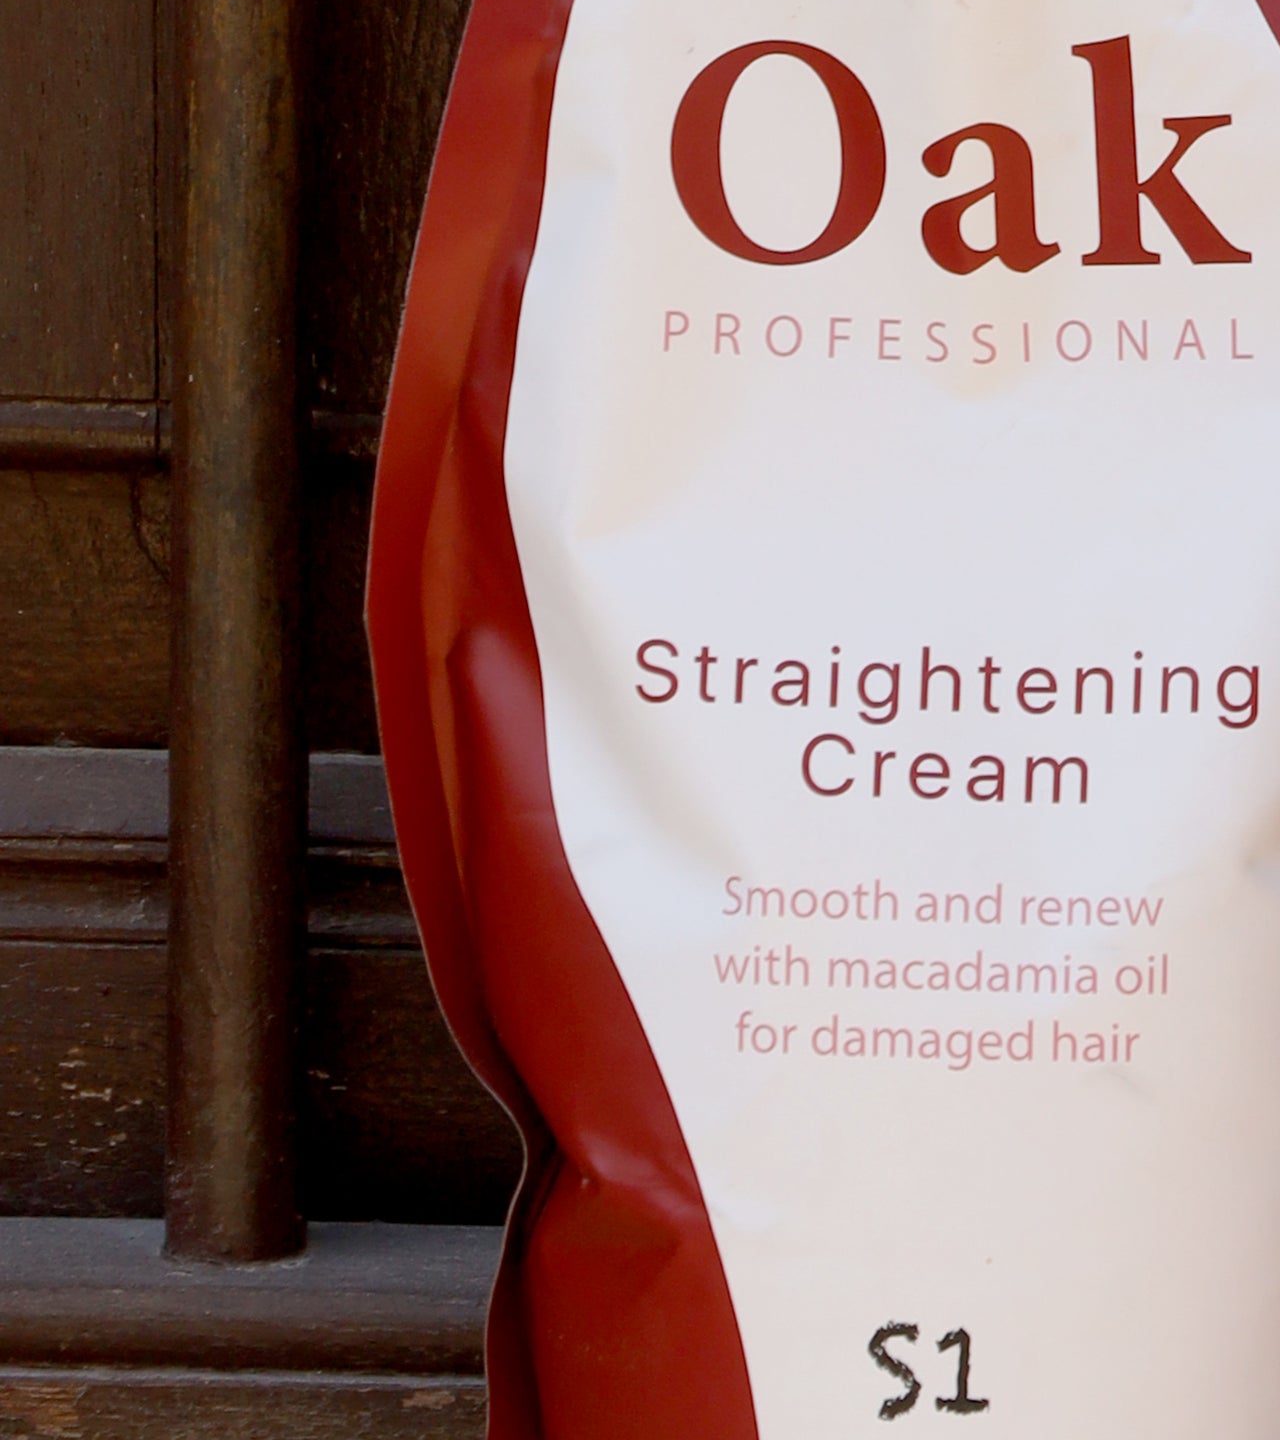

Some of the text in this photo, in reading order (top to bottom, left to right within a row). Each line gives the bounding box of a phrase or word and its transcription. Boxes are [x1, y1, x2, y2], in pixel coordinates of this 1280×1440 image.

[670, 35, 1252, 276] Oak
[662, 310, 1255, 365] PROFESSIONAL
[634, 639, 1262, 729] Straightening
[800, 732, 1090, 804] Cream
[722, 875, 1164, 927] Smooth and renew
[713, 945, 1169, 997] with macadamia oil
[734, 1012, 1139, 1071] for damaged hair
[867, 1321, 990, 1421] S1
